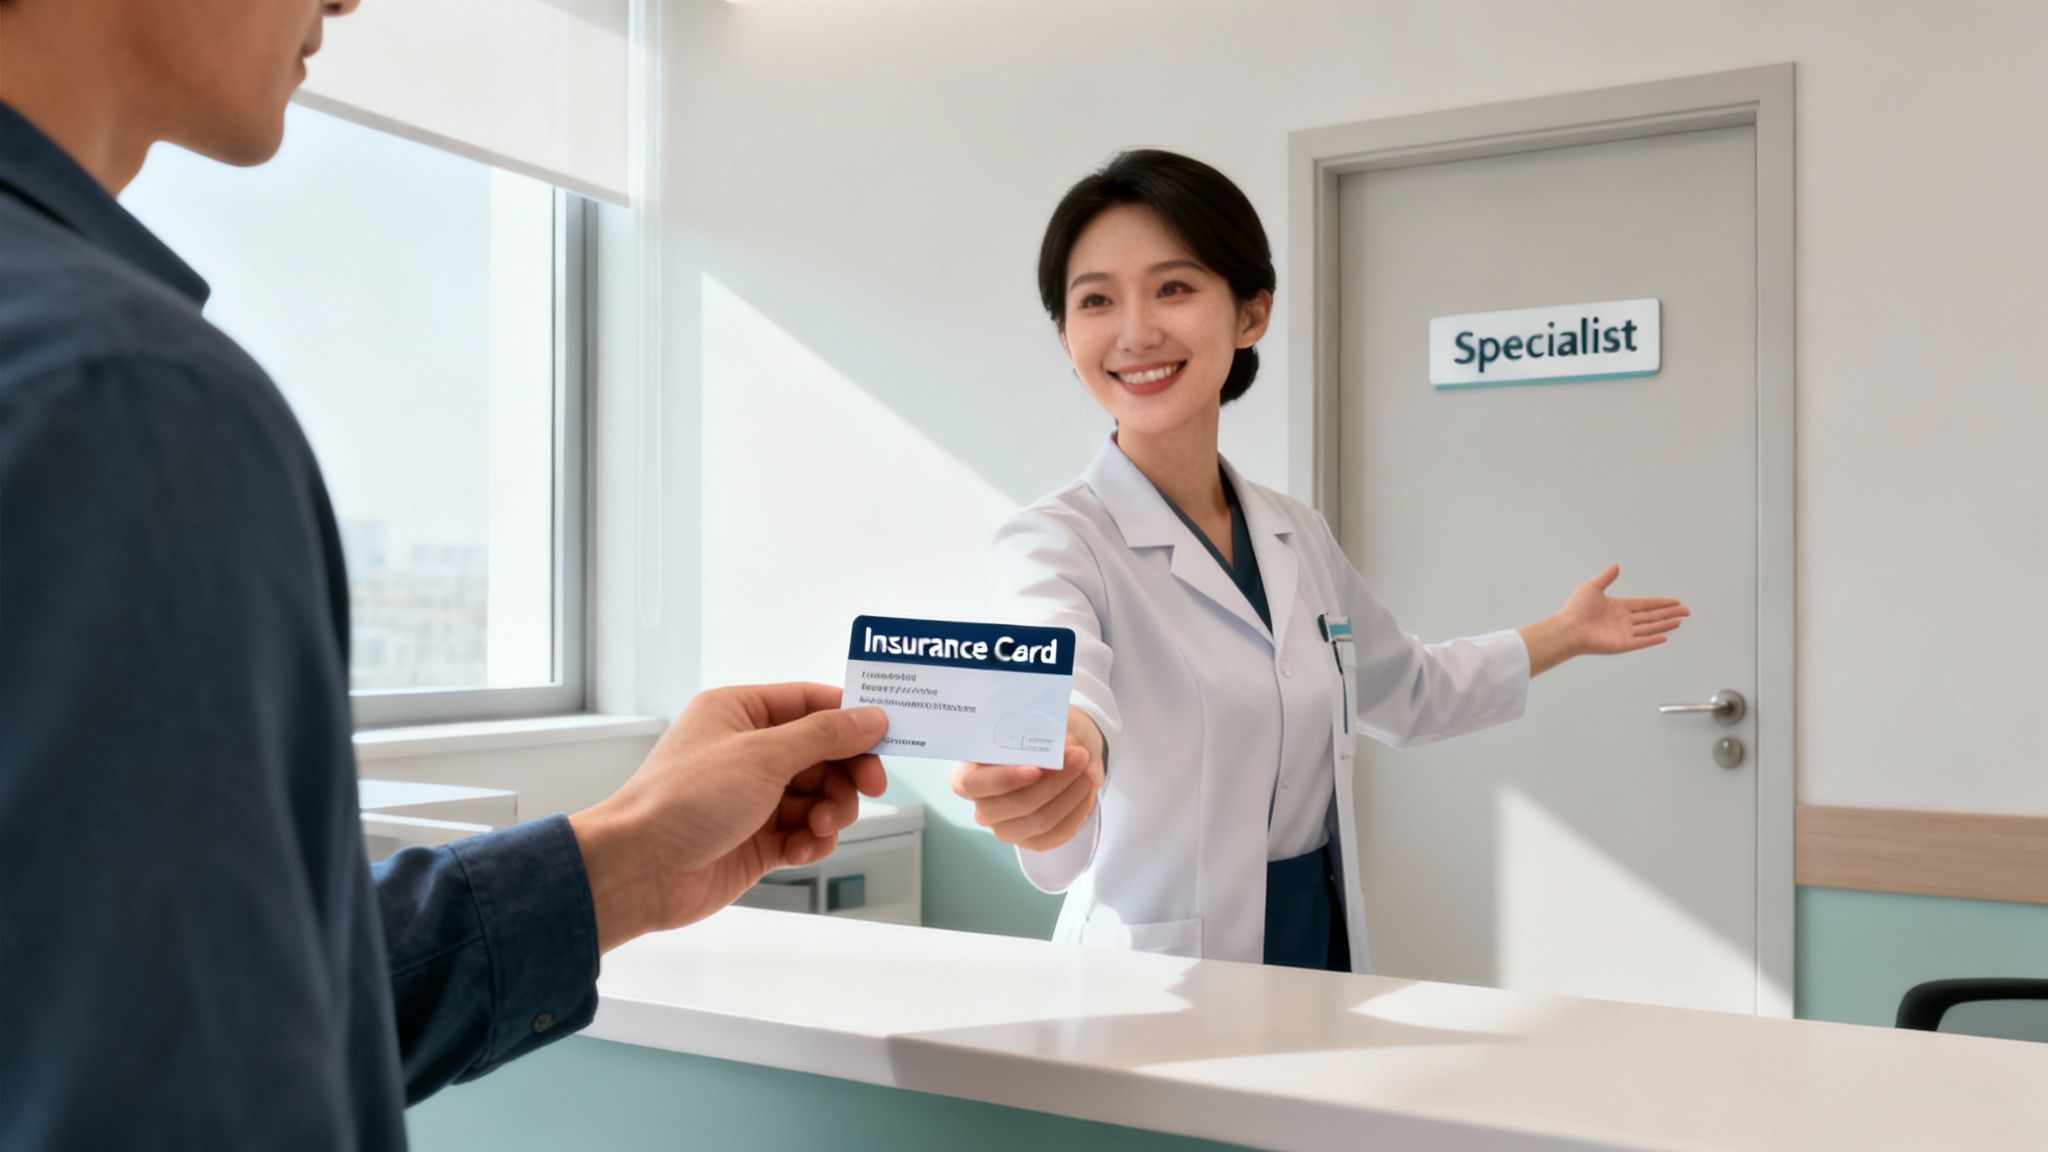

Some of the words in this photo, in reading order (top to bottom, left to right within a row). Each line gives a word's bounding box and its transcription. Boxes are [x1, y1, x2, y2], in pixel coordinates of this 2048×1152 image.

[1454, 316, 1638, 373] Specialist
[864, 627, 988, 660] Insurance
[994, 636, 1057, 665] Card
